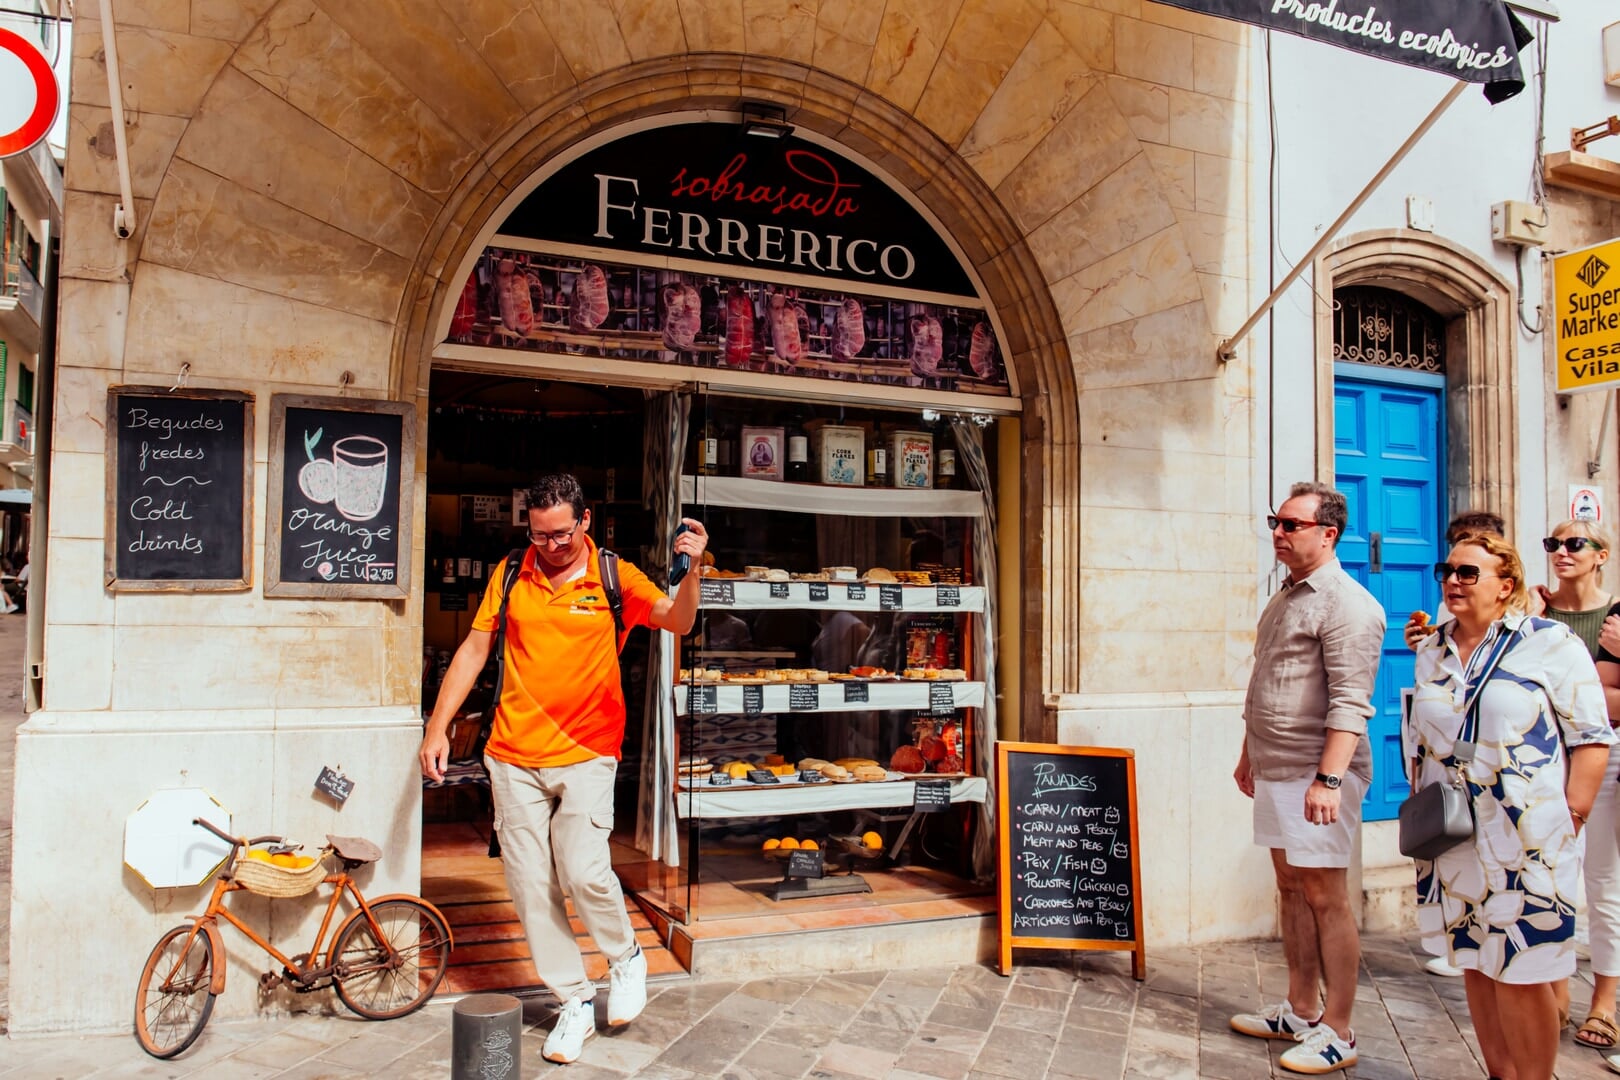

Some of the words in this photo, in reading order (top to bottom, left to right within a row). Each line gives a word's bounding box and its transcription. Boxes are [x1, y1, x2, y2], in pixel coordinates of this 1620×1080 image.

[671, 150, 862, 217] sobrasada
[1569, 288, 1620, 316] Super
[1562, 309, 1620, 339] Marke
[1565, 342, 1620, 362] Casa
[1571, 360, 1620, 379] Vila
[127, 407, 224, 440] Begudes
[139, 442, 205, 472] fredes
[130, 496, 193, 521] Cold
[128, 530, 204, 554] drinks
[300, 540, 377, 569] Juice
